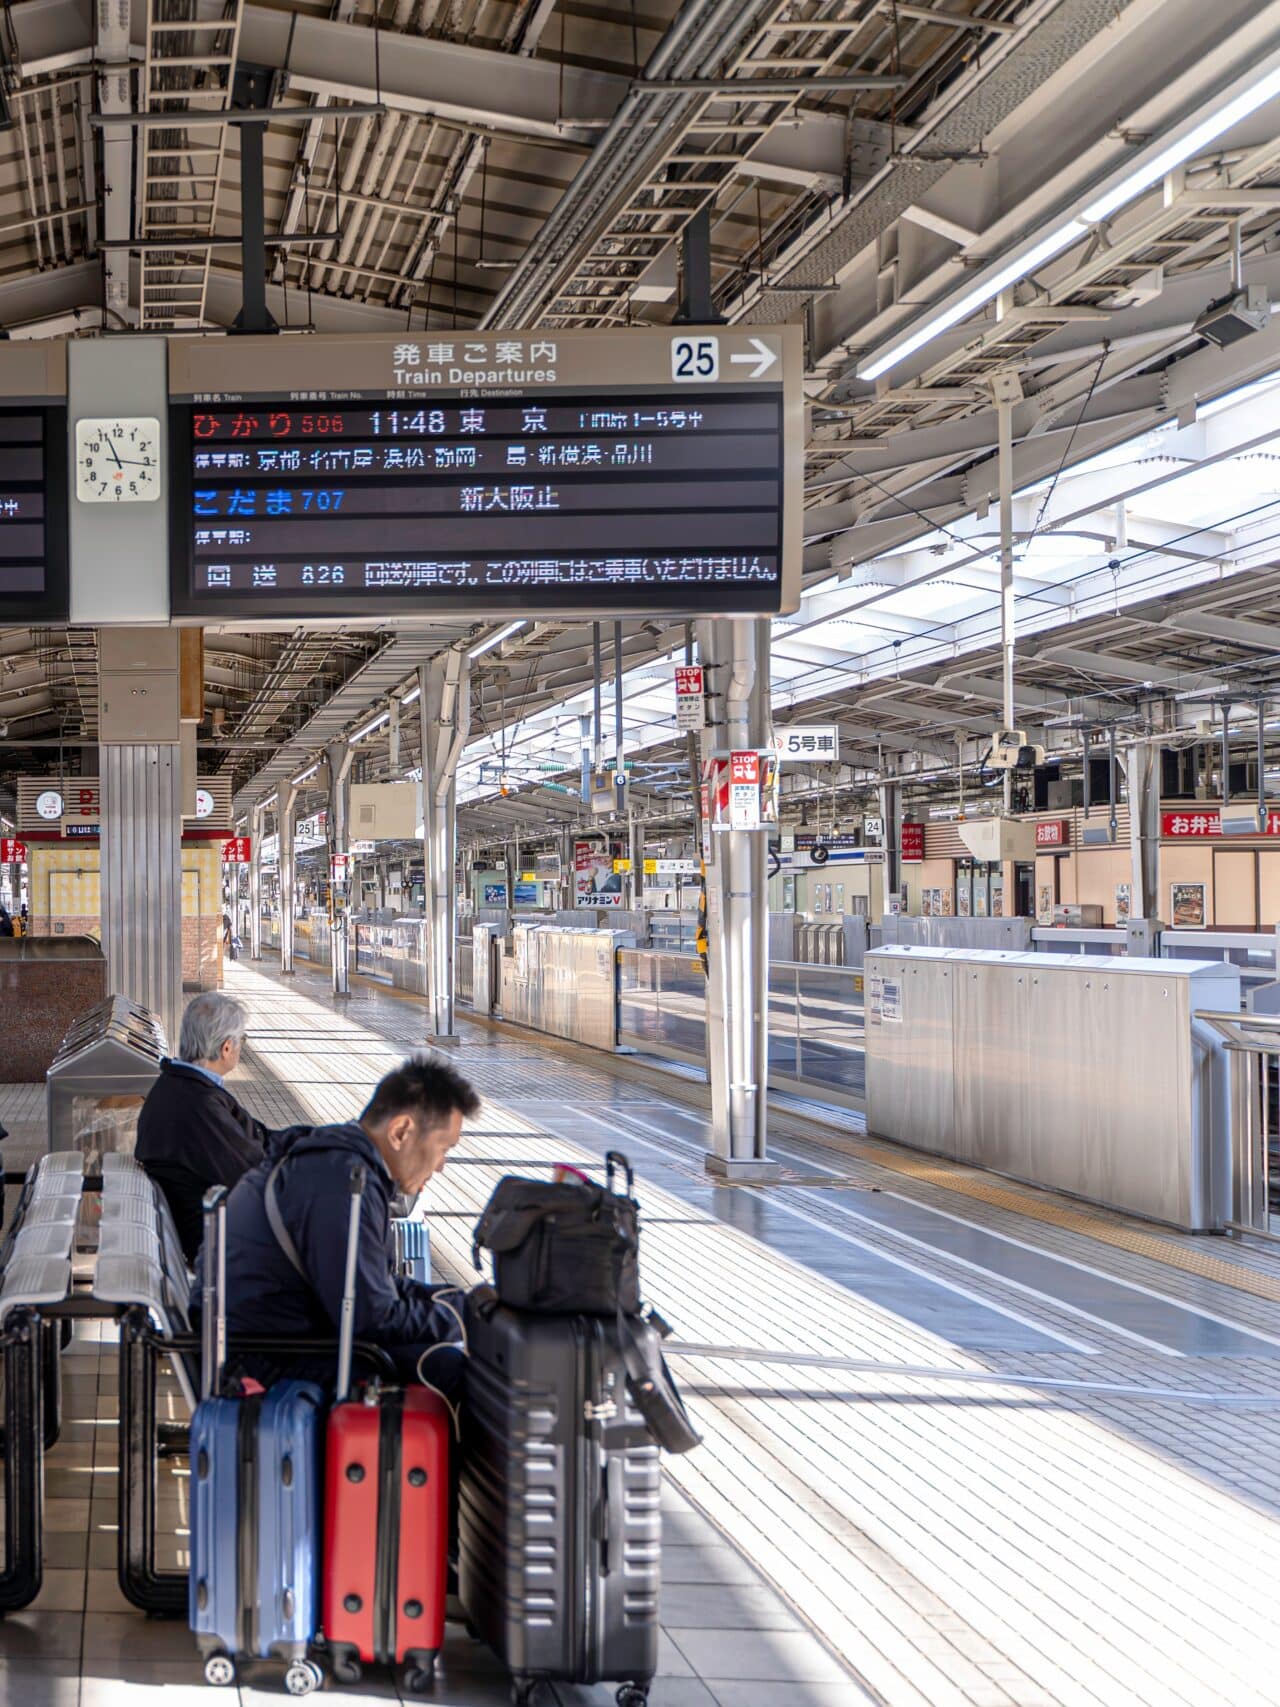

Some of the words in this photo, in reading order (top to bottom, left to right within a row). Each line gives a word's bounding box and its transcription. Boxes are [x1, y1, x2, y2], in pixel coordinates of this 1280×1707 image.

[393, 342, 557, 366] 発車ご案内
[676, 343, 714, 376] 25
[393, 368, 442, 385] Train
[449, 368, 557, 385] Departures
[330, 391, 348, 400] Train
[408, 390, 426, 399] Time
[481, 387, 523, 397] Destination
[224, 393, 242, 402] Train
[193, 412, 291, 437] ひかり
[302, 415, 344, 433] 506
[369, 411, 446, 434] 11:48
[460, 407, 548, 433] 東京
[99, 432, 108, 442] 11
[112, 428, 124, 438] 12
[130, 432, 135, 441] 1
[90, 442, 100, 453] 10
[140, 442, 146, 452] 2
[86, 458, 93, 467] 9
[143, 456, 150, 466] 3
[90, 471, 97, 481] 8
[139, 470, 146, 480] 4
[101, 482, 108, 491] 7
[115, 485, 122, 496] 6
[129, 481, 136, 491] 5
[193, 489, 292, 515] こだま
[301, 491, 345, 510] 707
[460, 485, 560, 511] 新大阪止
[677, 668, 700, 677] STOP
[788, 735, 834, 752] 5号車
[732, 756, 756, 764] STOP
[298, 824, 311, 834] 25
[867, 822, 879, 833] 24
[1171, 815, 1222, 834] お弁当
[577, 896, 621, 905] アリナミンV
